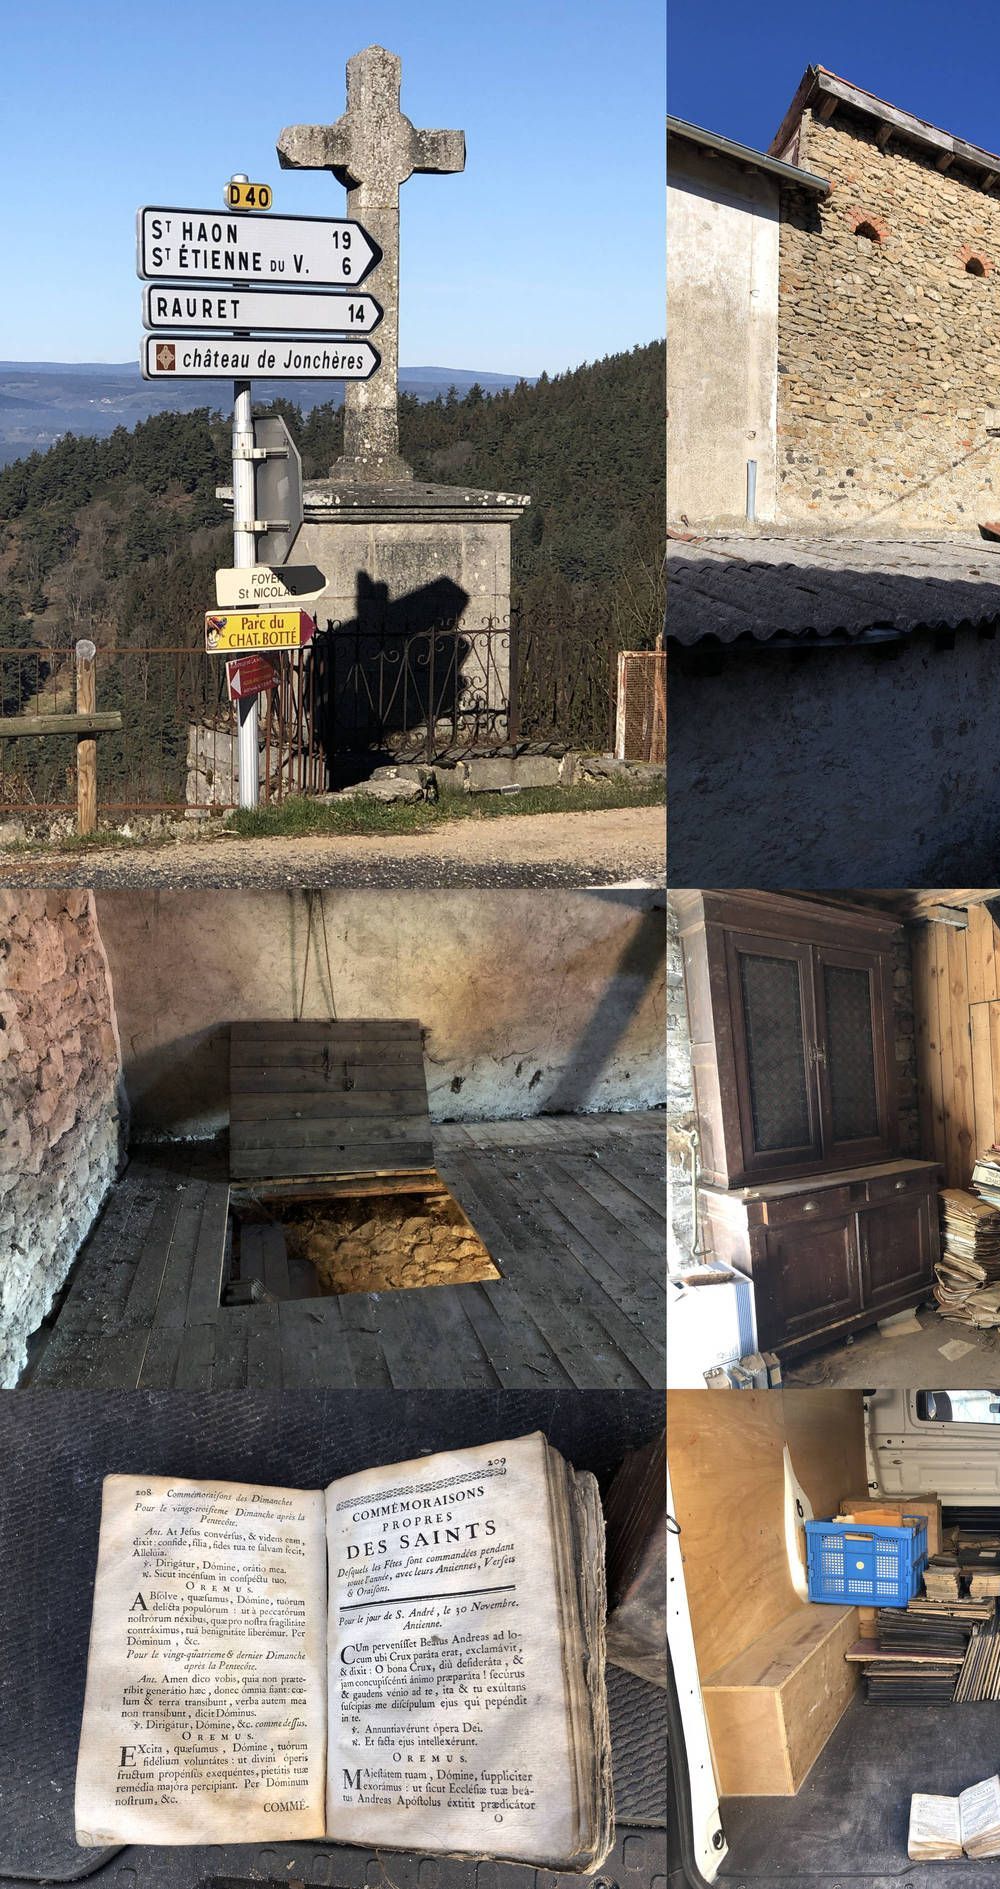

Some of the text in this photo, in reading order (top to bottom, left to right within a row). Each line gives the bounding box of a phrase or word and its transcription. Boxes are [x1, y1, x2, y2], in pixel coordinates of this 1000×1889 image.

[183, 222, 238, 243] HAON
[333, 231, 351, 249] 19
[179, 244, 262, 272] ÉTIENNE
[270, 260, 285, 272] DU
[294, 254, 309, 274] V.
[342, 257, 351, 275] 6
[158, 297, 365, 323] RAURET 14
[183, 349, 363, 370] château de Jonchères
[239, 588, 249, 599] St
[242, 615, 284, 630] Parc du
[229, 627, 296, 647] CHAT BOTTÉ
[488, 1457, 507, 1466] 209
[236, 1494, 247, 1502] des
[252, 1495, 293, 1506] Dimanches
[353, 1486, 484, 1522] COMMÉMORAISONS
[135, 1503, 155, 1512] Pour
[235, 1508, 274, 1519] Dimanche
[277, 1514, 296, 1522] après
[383, 1512, 453, 1533] PROPRES
[259, 1534, 283, 1542] videns
[347, 1520, 496, 1559] DES SAINTS
[213, 1540, 230, 1549] fides
[234, 1542, 246, 1550] tua
[426, 1550, 477, 1563] commandées
[480, 1542, 514, 1558] pendant
[396, 1570, 412, 1579] avec
[415, 1567, 433, 1576] leurs
[365, 1614, 381, 1625] jour
[384, 1612, 392, 1620] de
[396, 1610, 404, 1619] S.
[444, 1607, 451, 1615] le
[456, 1606, 467, 1616] 30
[471, 1600, 519, 1612] Novembre.
[292, 1629, 305, 1637] Per
[452, 1630, 522, 1643] Andreas ad lo-
[127, 1650, 148, 1658] Pour
[152, 1650, 158, 1658] le
[237, 1651, 263, 1659] dernier
[266, 1651, 306, 1659] Dimanche
[356, 1655, 372, 1664] cum
[375, 1653, 387, 1662] ubi
[390, 1652, 411, 1661] Crux
[184, 1663, 205, 1672] après
[209, 1662, 216, 1670] la
[375, 1664, 384, 1673] O
[387, 1664, 407, 1673] bona
[512, 1655, 523, 1664] &
[162, 1675, 188, 1683] Amen
[192, 1674, 210, 1683] dico
[242, 1676, 259, 1686] quia
[341, 1691, 349, 1699] &
[353, 1689, 383, 1700] gaudens
[412, 1687, 421, 1696] ad
[443, 1686, 454, 1694] ita
[459, 1684, 467, 1693] &
[473, 1685, 483, 1693] tu
[235, 1697, 258, 1705] verba
[440, 1699, 458, 1710] ejus
[121, 1709, 138, 1717] non
[195, 1709, 214, 1718] dicit
[341, 1714, 361, 1723] in te.
[463, 1723, 483, 1733] Dei.
[365, 1737, 374, 1746] Et
[398, 1737, 415, 1750] ejus
[244, 1780, 260, 1788] Per
[358, 1794, 392, 1804] Andreas
[494, 1814, 503, 1822] O
